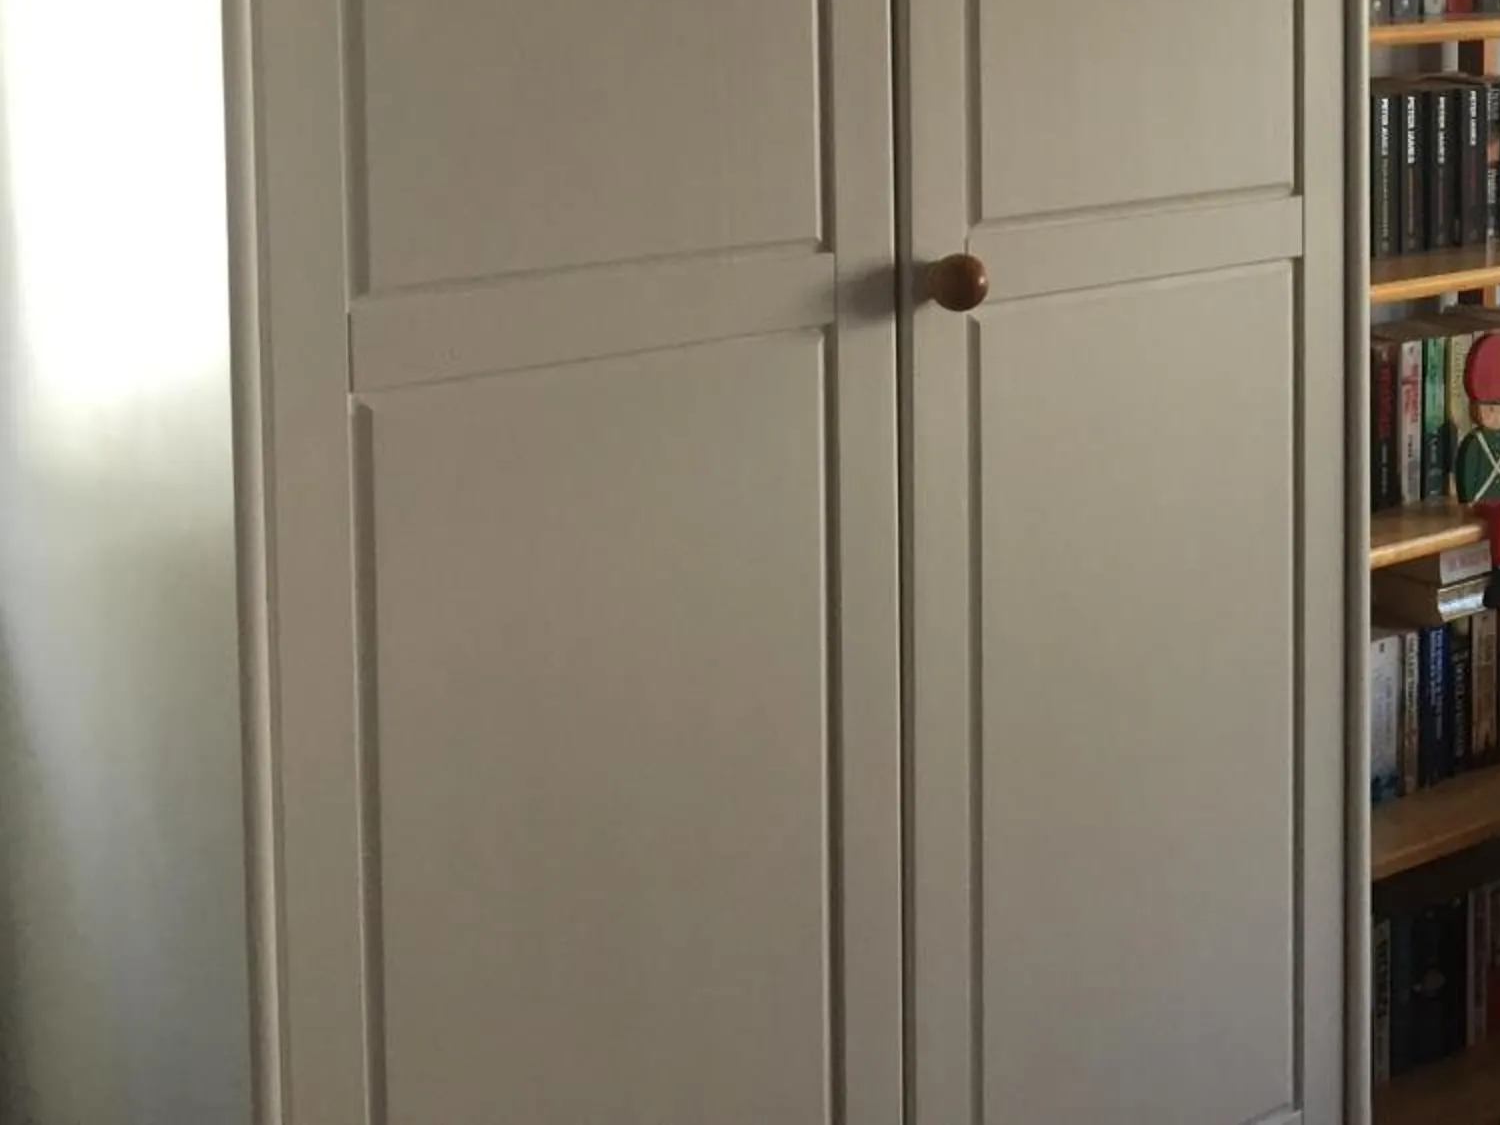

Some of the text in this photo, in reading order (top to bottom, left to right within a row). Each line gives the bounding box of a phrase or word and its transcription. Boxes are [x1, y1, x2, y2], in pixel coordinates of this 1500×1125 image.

[1381, 98, 1389, 126] PETER
[1407, 96, 1415, 128] PETER
[1407, 130, 1415, 164] JAMES
